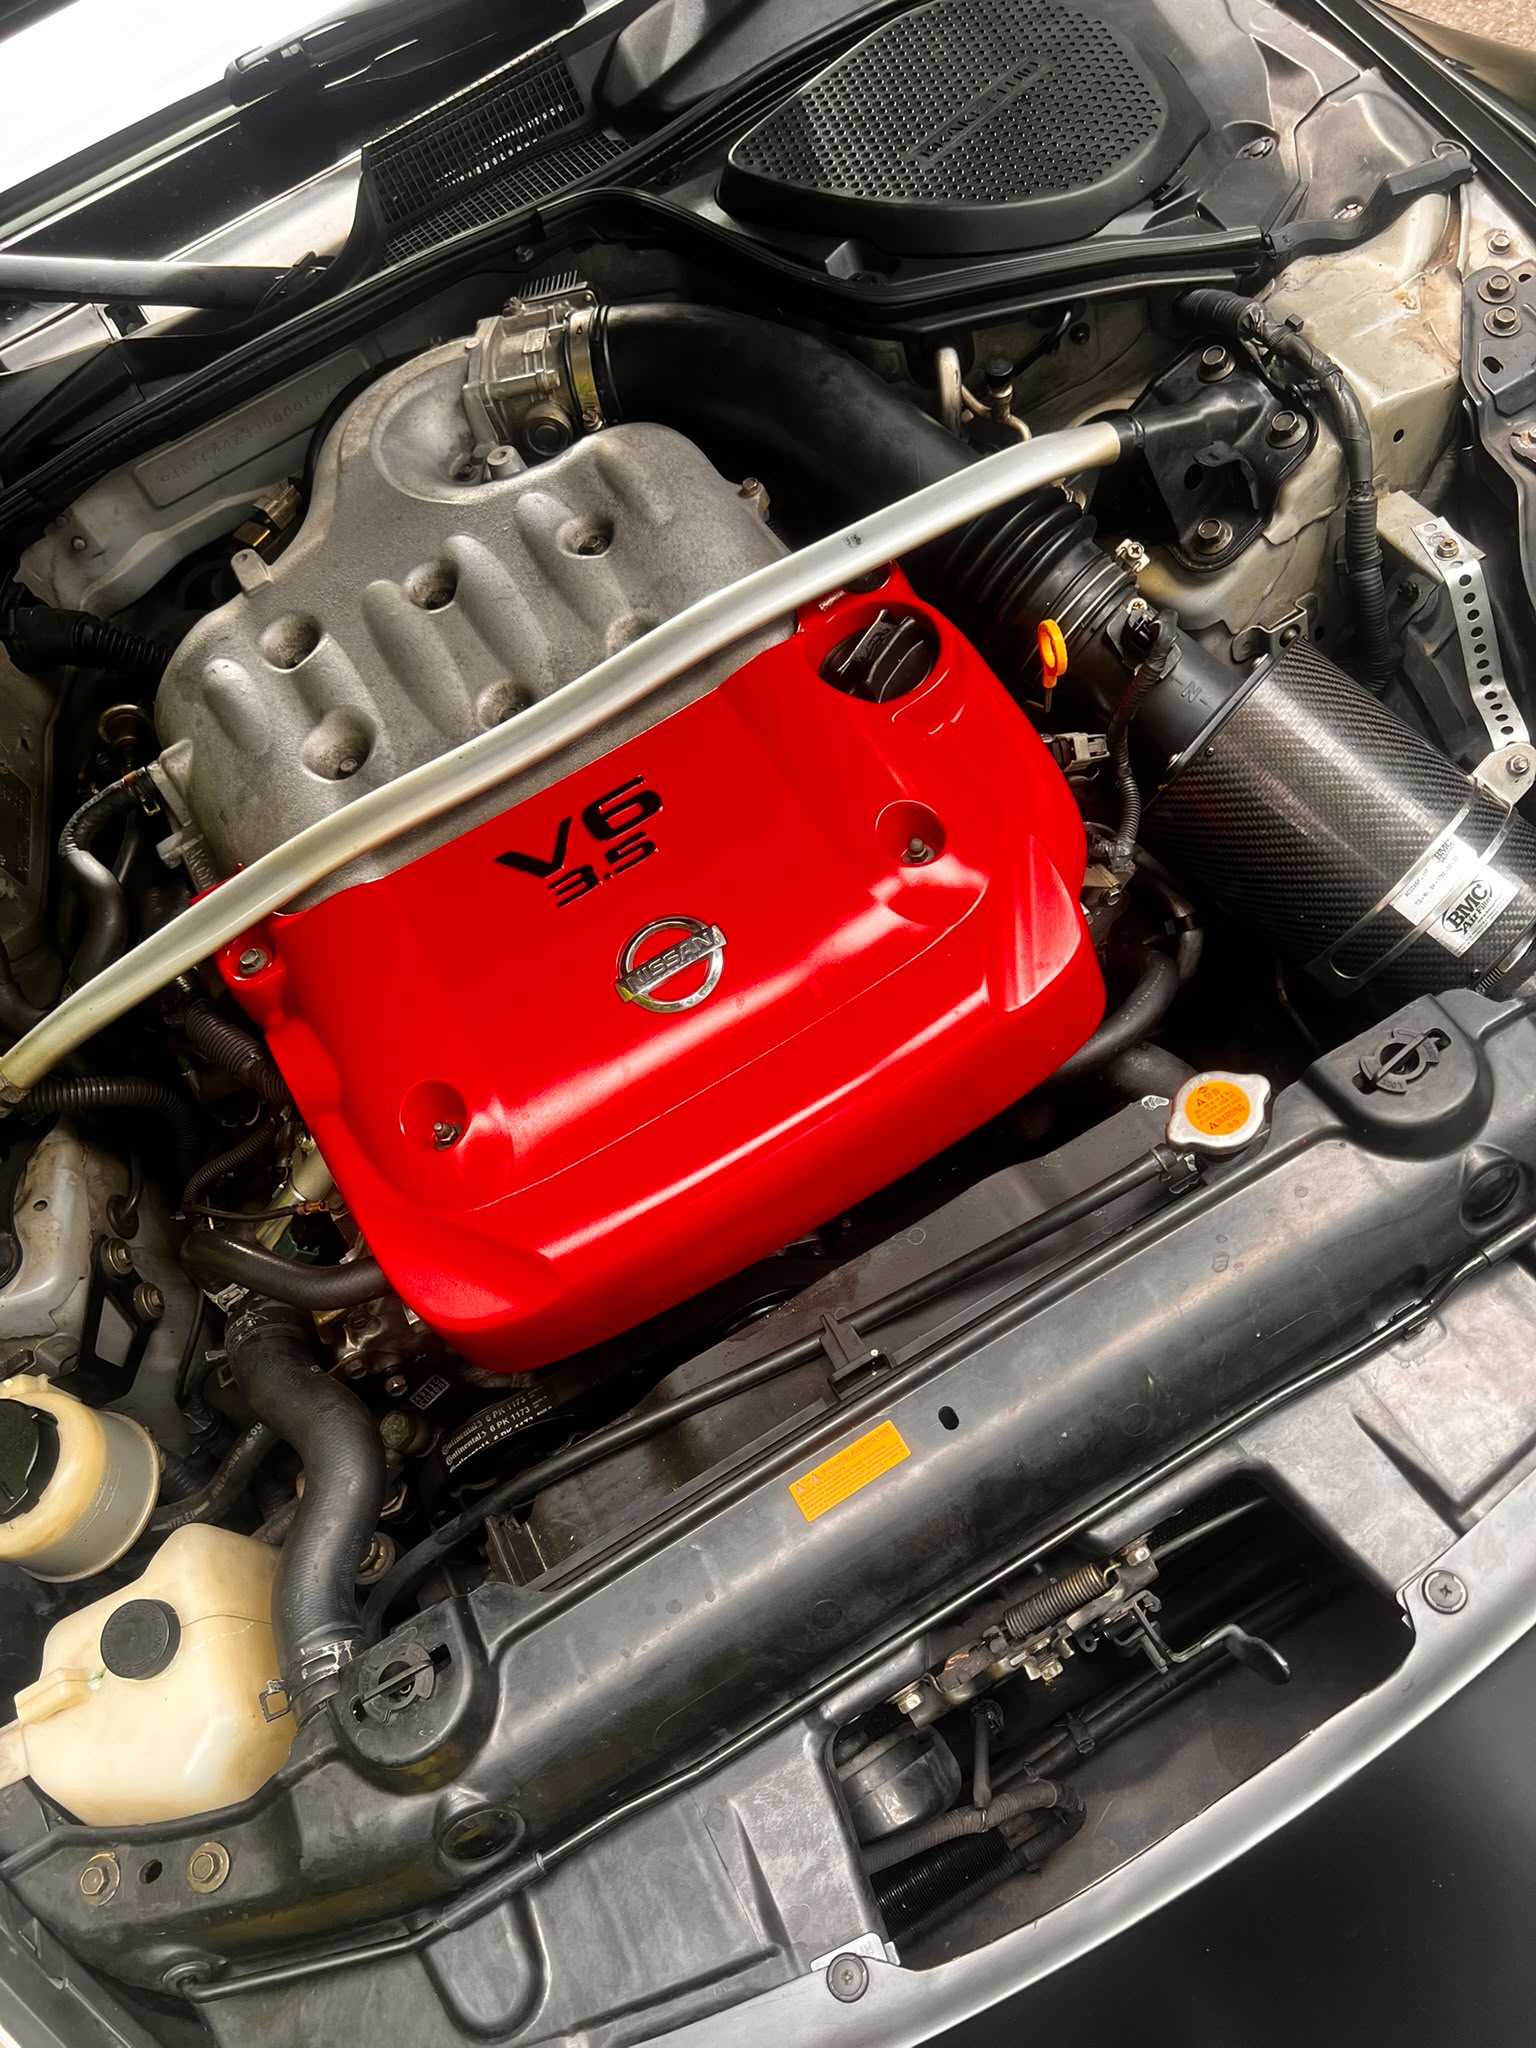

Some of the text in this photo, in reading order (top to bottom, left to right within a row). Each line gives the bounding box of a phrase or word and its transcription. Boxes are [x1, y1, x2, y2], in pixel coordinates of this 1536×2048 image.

[494, 775, 663, 879] V6
[548, 831, 659, 908] 3.5
[1446, 883, 1488, 929] BMC
[1462, 913, 1479, 934] Air
[625, 930, 714, 991] NISSAN
[445, 1431, 482, 1466] Continental
[496, 1417, 510, 1430] PK
[511, 1407, 531, 1421] 1173
